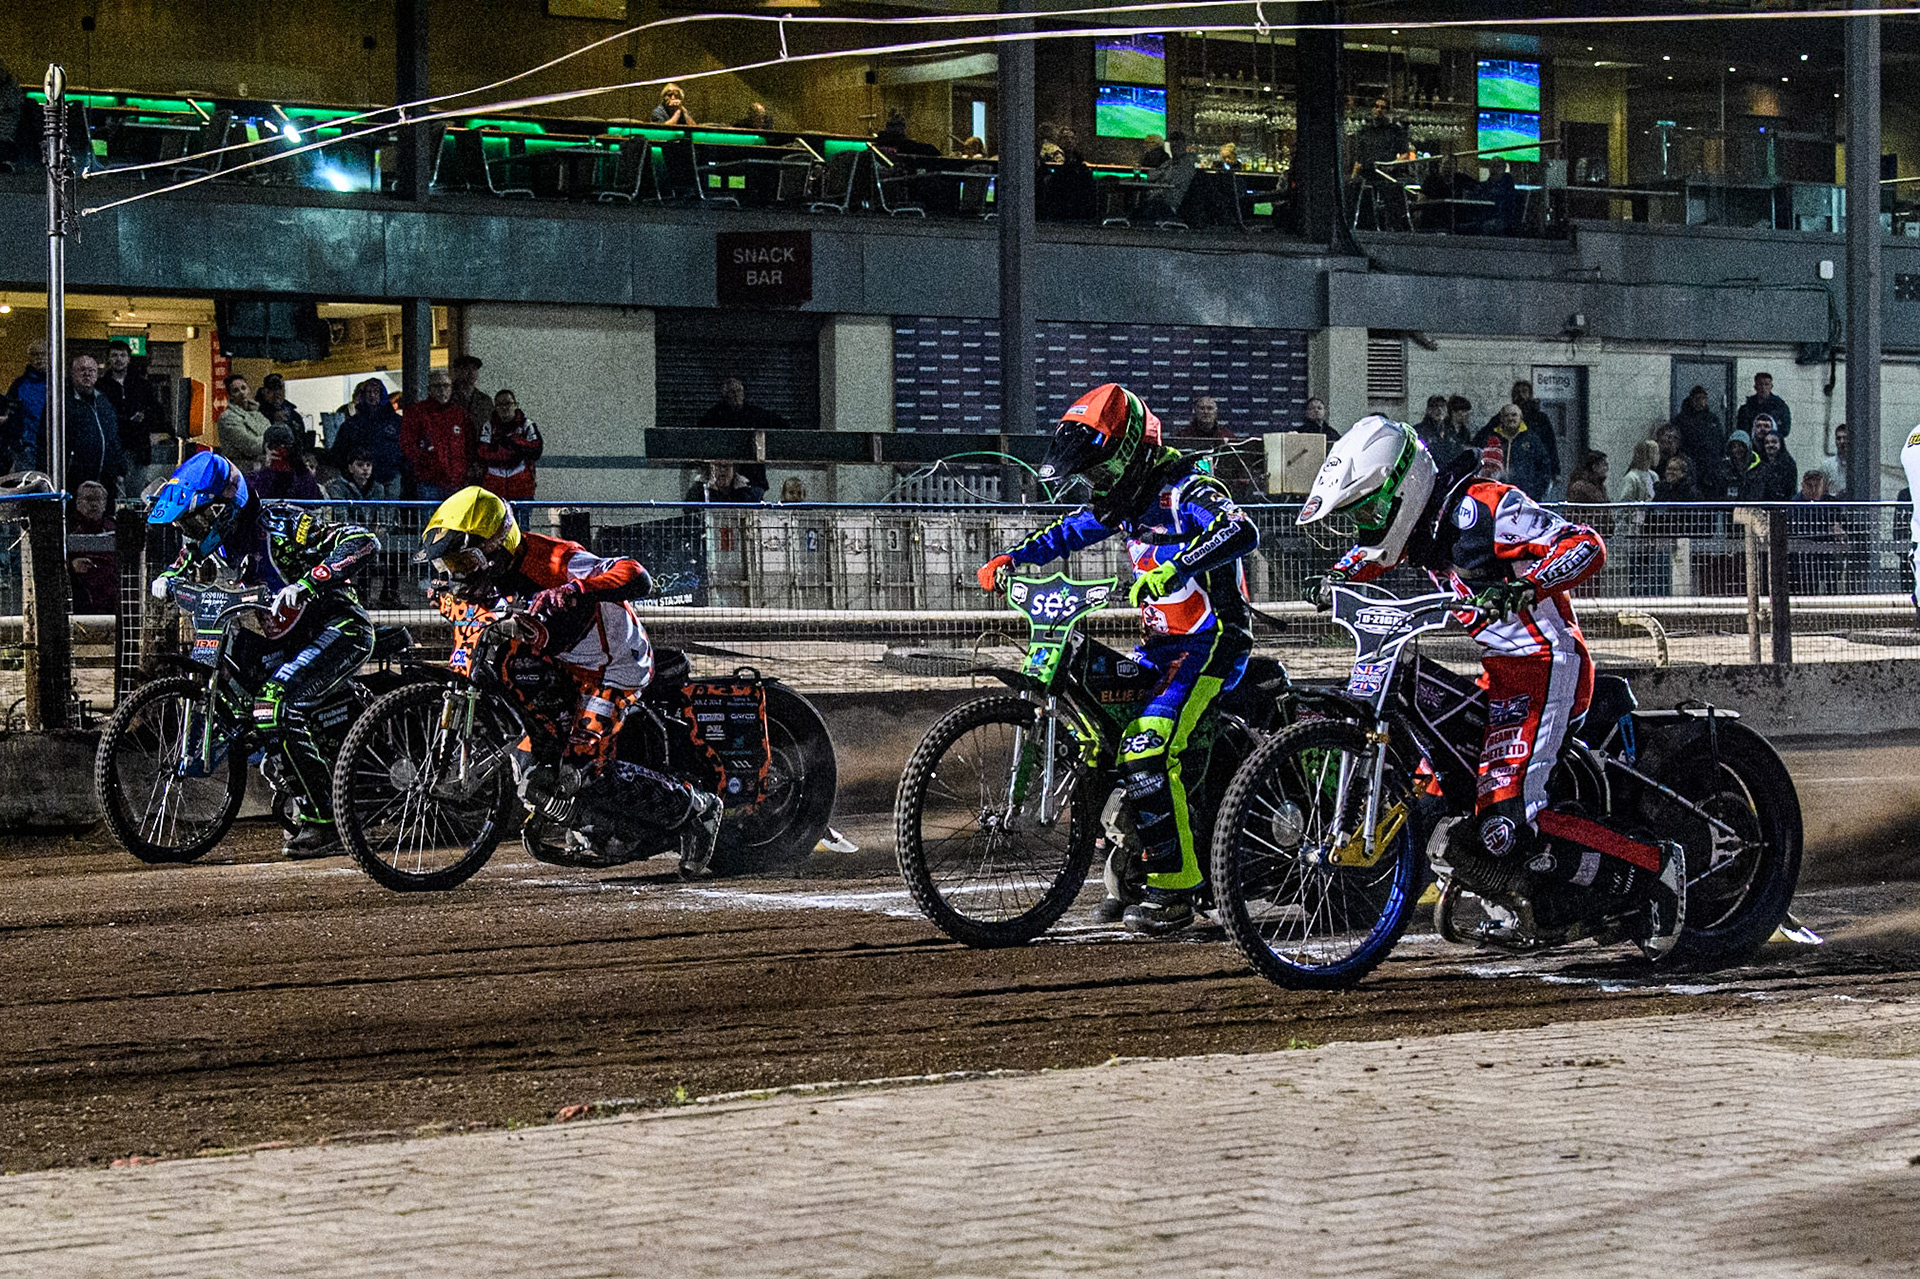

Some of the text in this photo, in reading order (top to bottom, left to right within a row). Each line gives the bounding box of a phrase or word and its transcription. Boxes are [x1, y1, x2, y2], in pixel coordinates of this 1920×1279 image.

[733, 247, 795, 264] SNACK
[746, 270, 782, 286] BAR
[1537, 373, 1570, 388] Betting
[808, 531, 817, 549] 2
[890, 530, 897, 549] 3
[1184, 524, 1240, 564] Grandad Fred
[659, 594, 692, 607] STADIUM
[1031, 591, 1078, 618] ses
[1101, 690, 1135, 702] ELLIE
[1505, 743, 1525, 756] LTD
